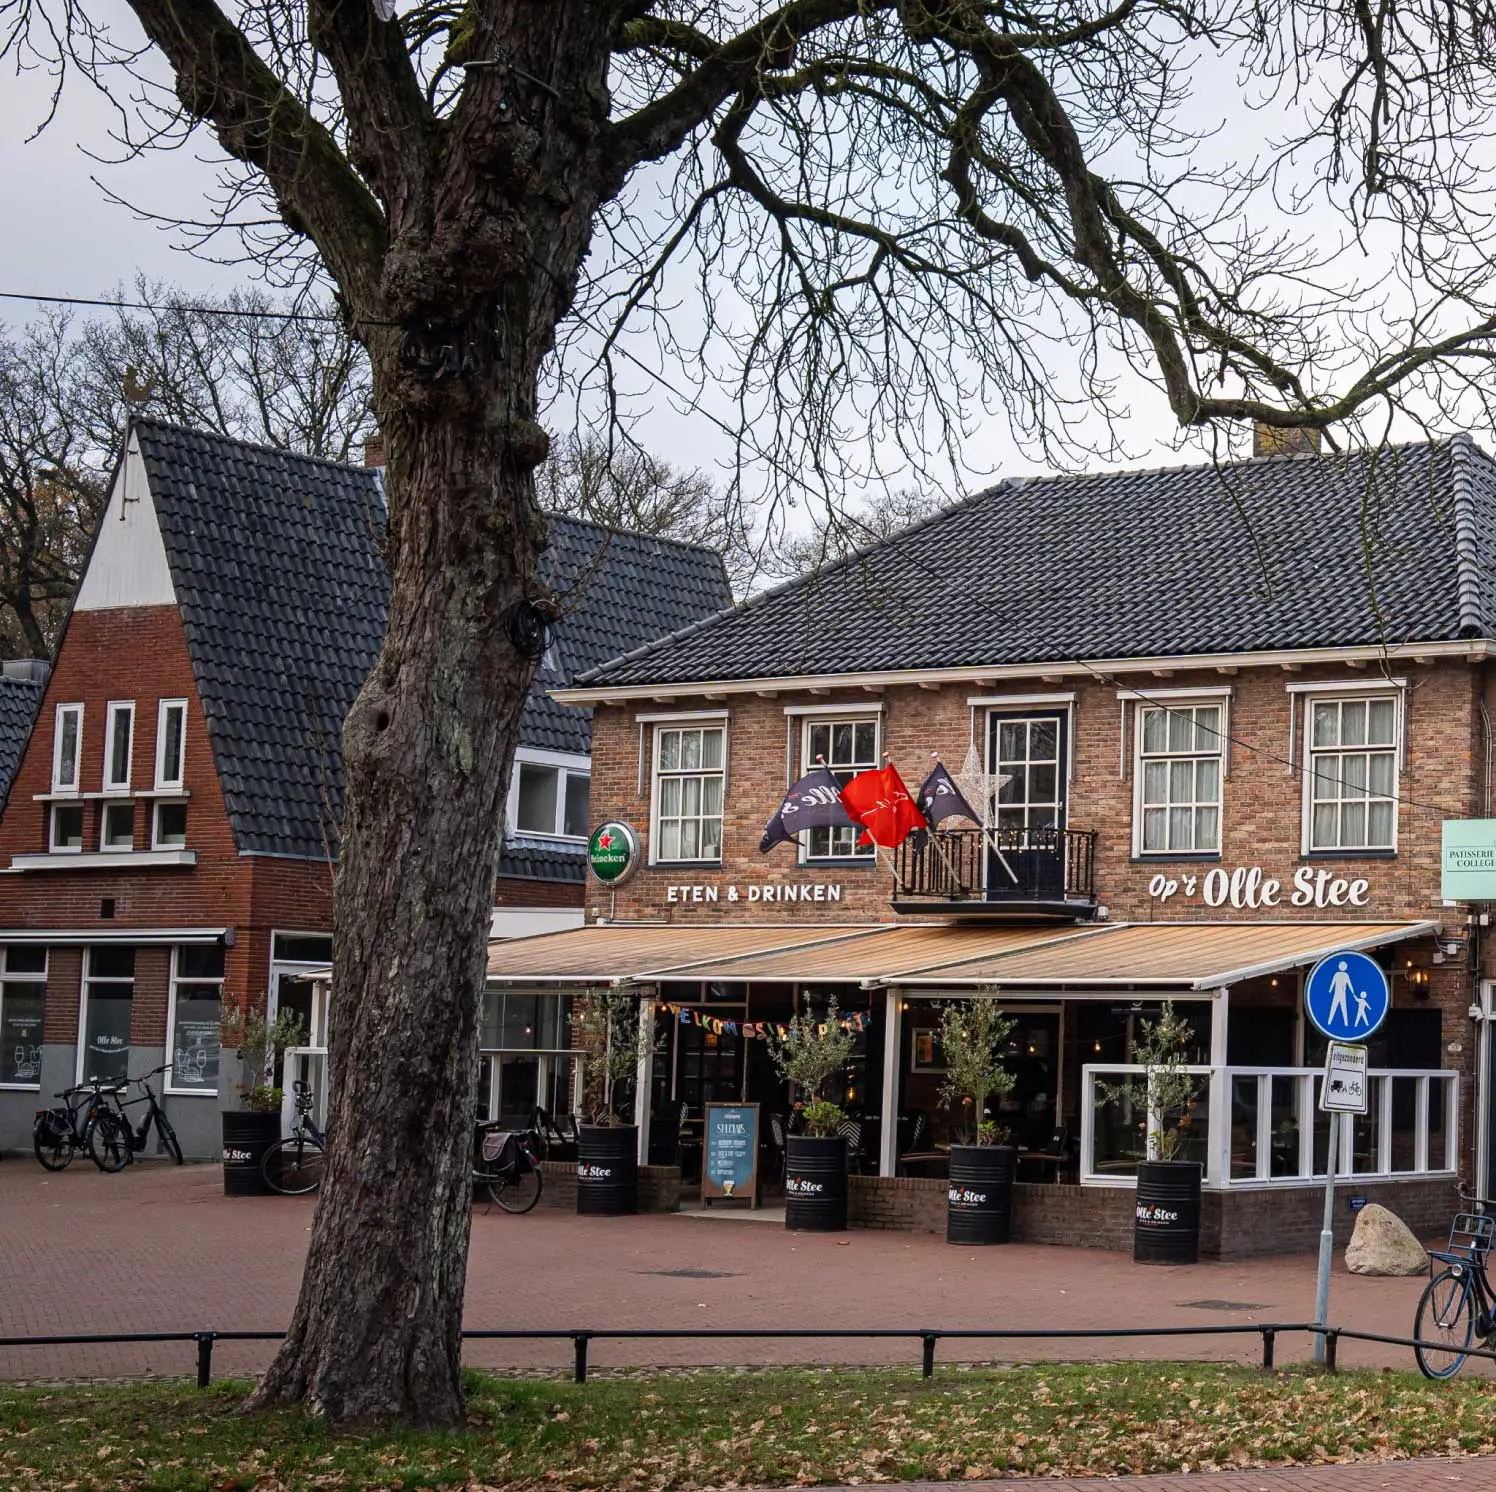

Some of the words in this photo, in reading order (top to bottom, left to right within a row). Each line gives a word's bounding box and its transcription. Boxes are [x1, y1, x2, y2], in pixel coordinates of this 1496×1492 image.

[1449, 850, 1494, 859] PATISSERIE
[667, 885, 718, 902] ETEN
[727, 885, 739, 902] &
[748, 884, 841, 902] DRINKEN
[1149, 873, 1178, 902] Op
[1203, 866, 1281, 909] Olle
[1291, 866, 1370, 908] Stee
[231, 1149, 252, 1159] Stee
[589, 1166, 612, 1177] Stee
[800, 1180, 823, 1192] Stee
[963, 1190, 986, 1202] Stee
[1153, 1207, 1178, 1220] Stee
